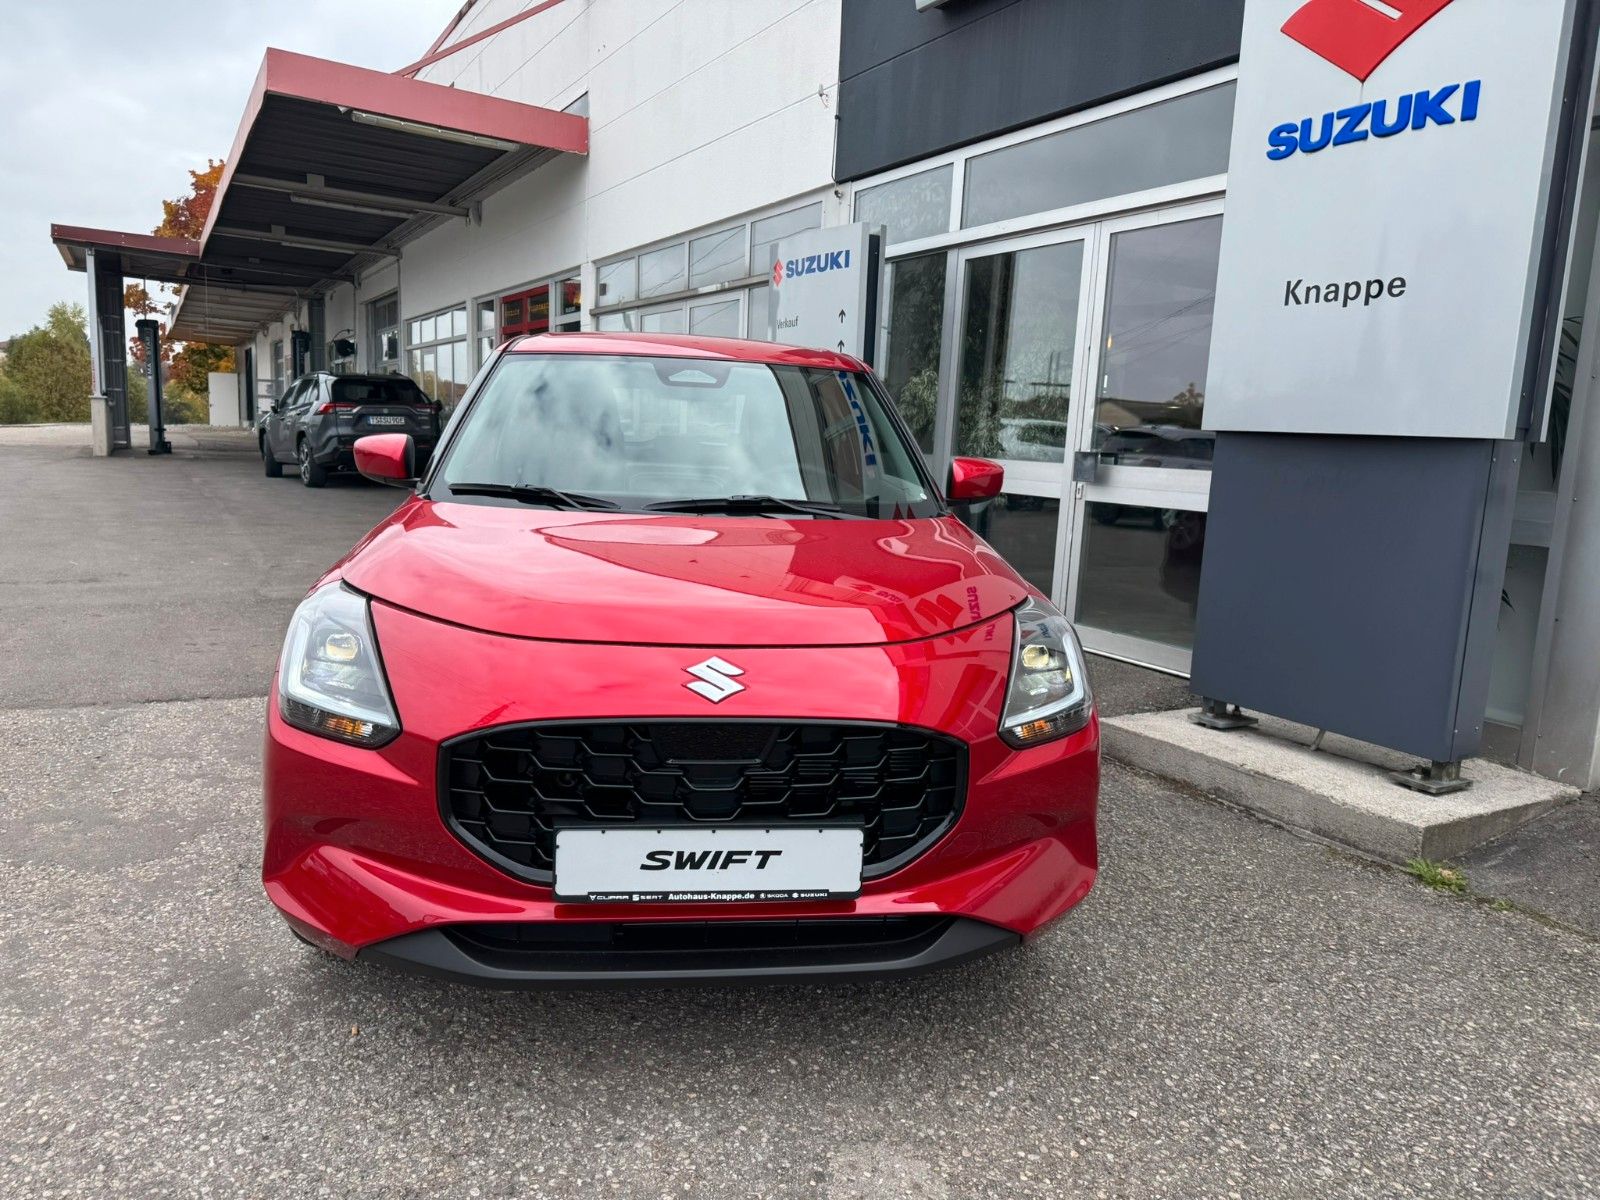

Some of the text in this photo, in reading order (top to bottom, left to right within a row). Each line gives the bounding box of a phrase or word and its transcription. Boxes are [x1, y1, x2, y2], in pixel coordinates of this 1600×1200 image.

[1266, 79, 1481, 161] SUZUKI
[786, 249, 851, 279] SUZUKI
[1283, 275, 1407, 308] Knappe
[640, 850, 783, 870] SWIFT
[668, 893, 755, 901] Autohaus-Knappe.de
